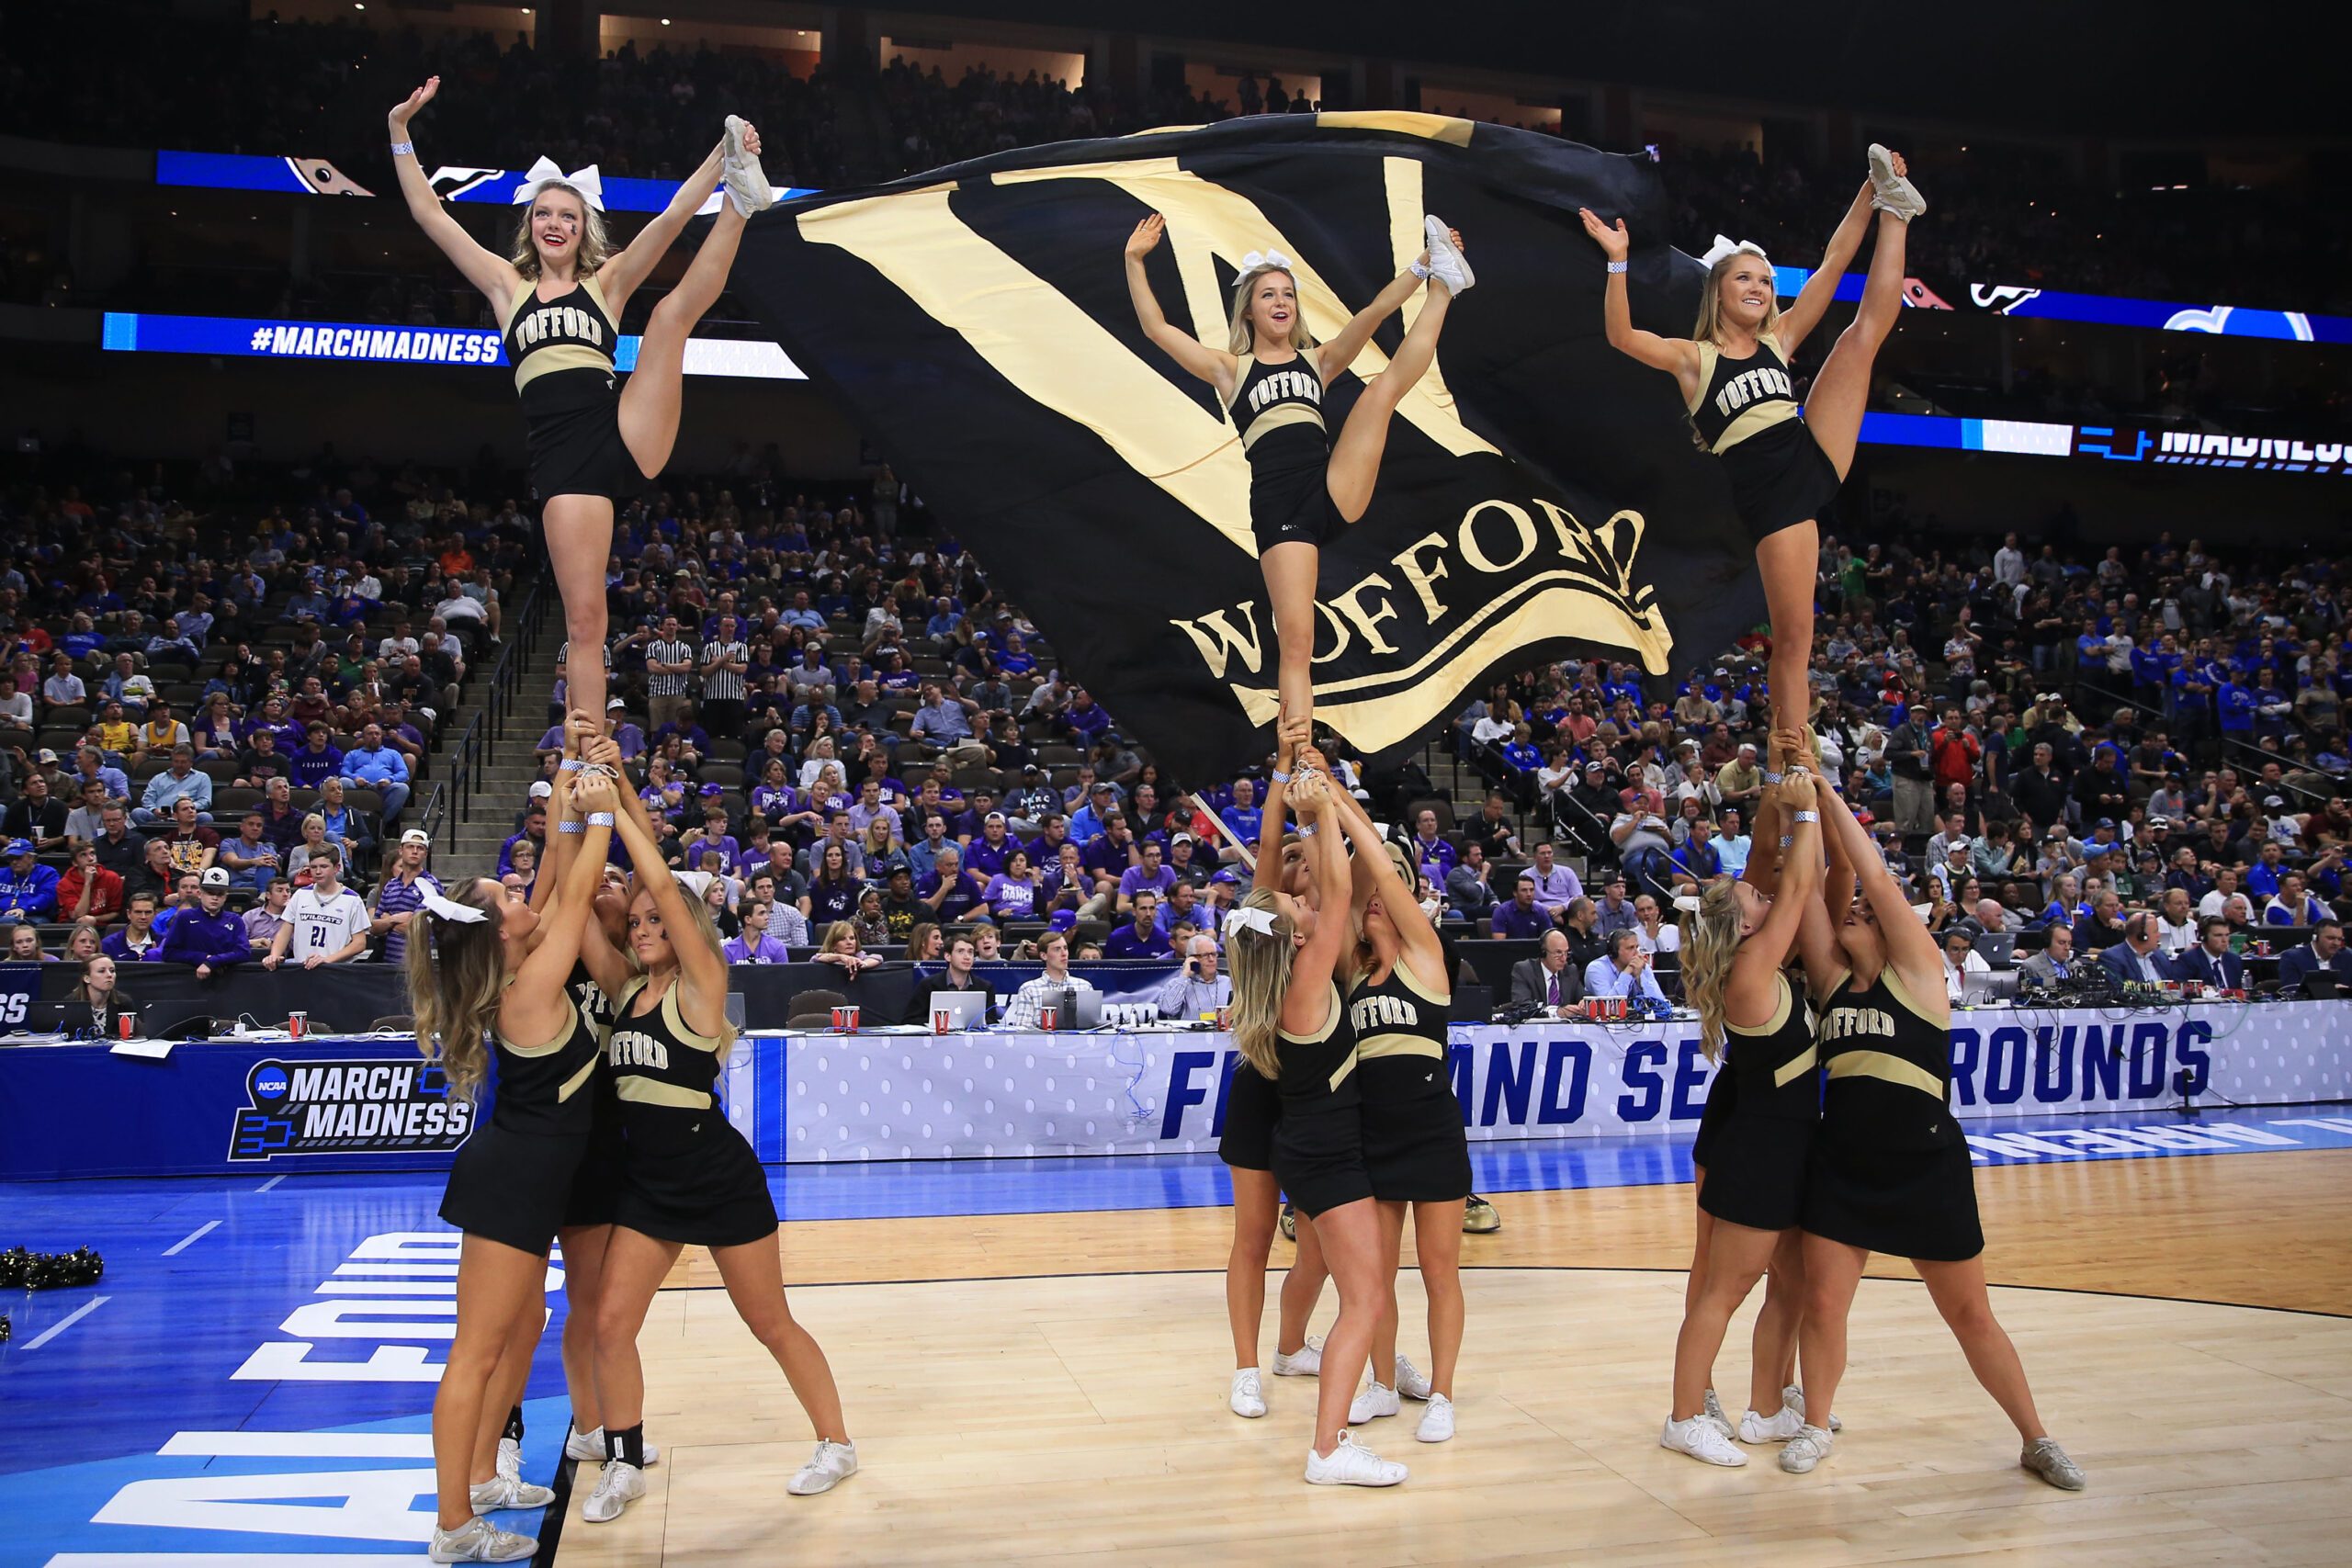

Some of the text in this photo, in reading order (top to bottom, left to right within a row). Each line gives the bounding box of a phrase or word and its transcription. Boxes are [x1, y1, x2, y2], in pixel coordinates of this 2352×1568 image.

[250, 326, 501, 364] #MARCHMADNESS
[300, 913, 343, 925] WILDCATS
[311, 926, 326, 947] 21
[1350, 995, 1418, 1039] OFFORD
[1820, 1007, 1894, 1044] OFFORD
[609, 1031, 669, 1070] OFFORD
[1949, 1021, 2212, 1106] ROUNDS
[257, 1081, 287, 1091] NCAA
[288, 1067, 413, 1101] MARCH
[303, 1103, 469, 1138] MADNESS
[1964, 1122, 2304, 1160] AREN
